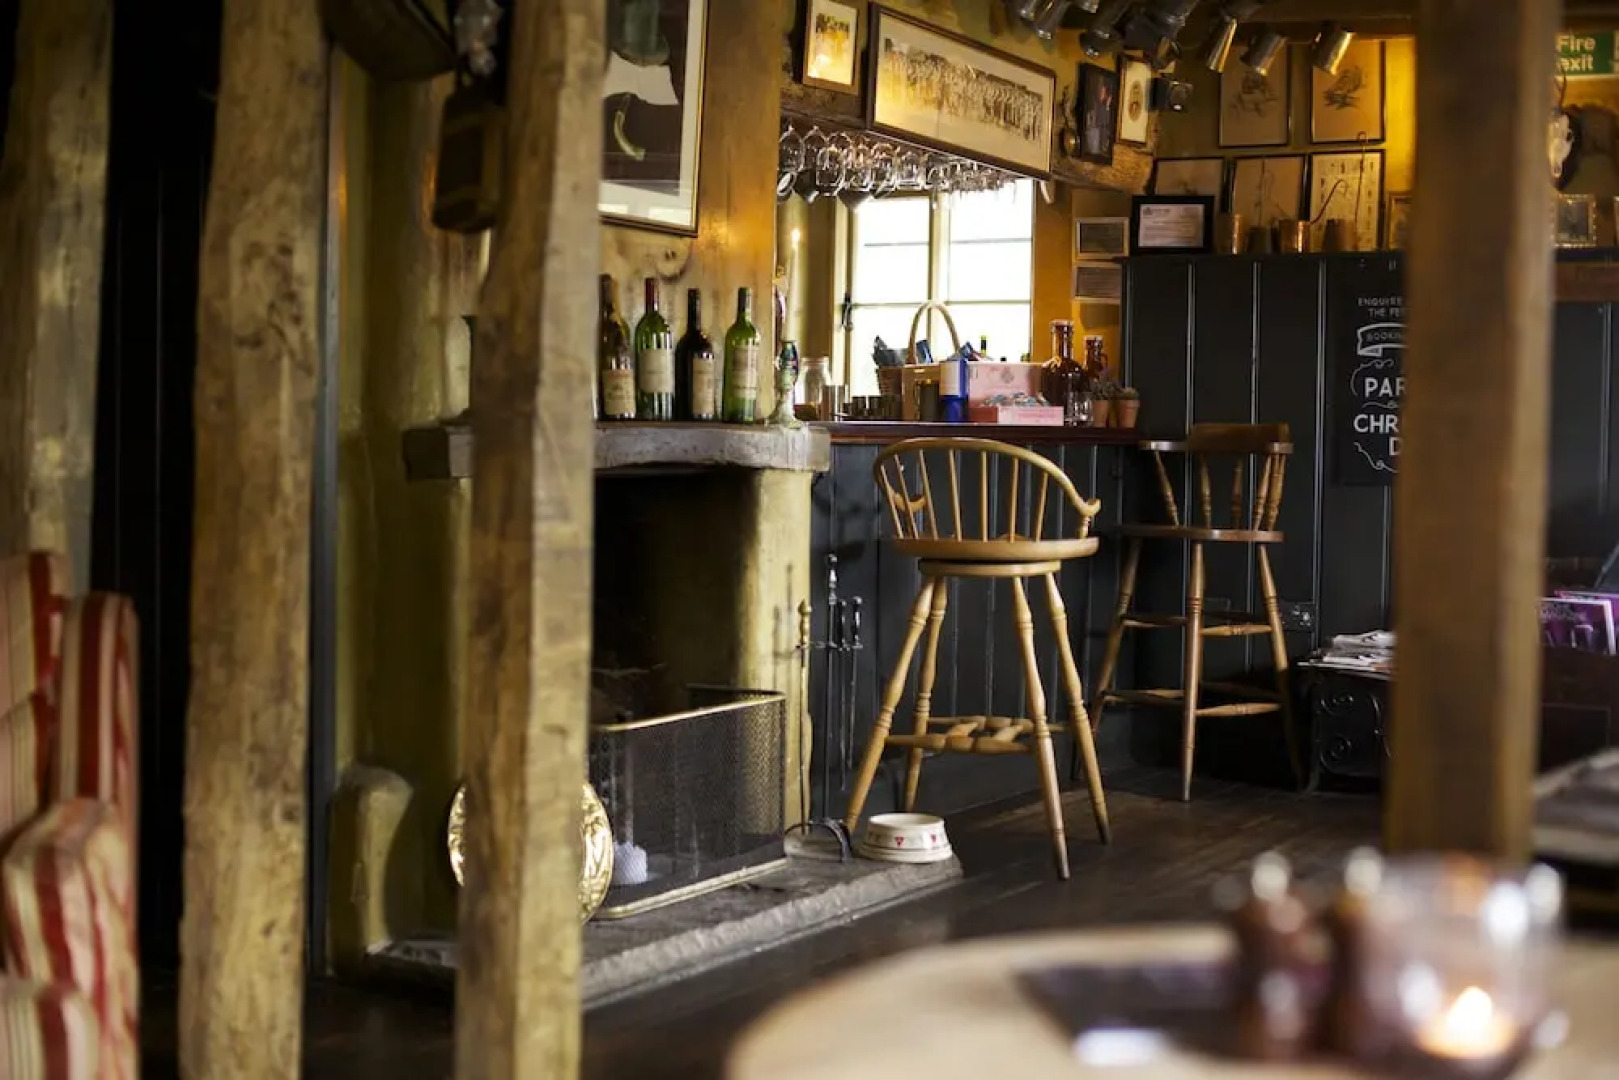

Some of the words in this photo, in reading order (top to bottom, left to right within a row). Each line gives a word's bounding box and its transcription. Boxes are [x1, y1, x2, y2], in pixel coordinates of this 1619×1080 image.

[1556, 35, 1595, 53] Fire
[1368, 307, 1385, 317] THE
[1353, 413, 1400, 434] CHR
